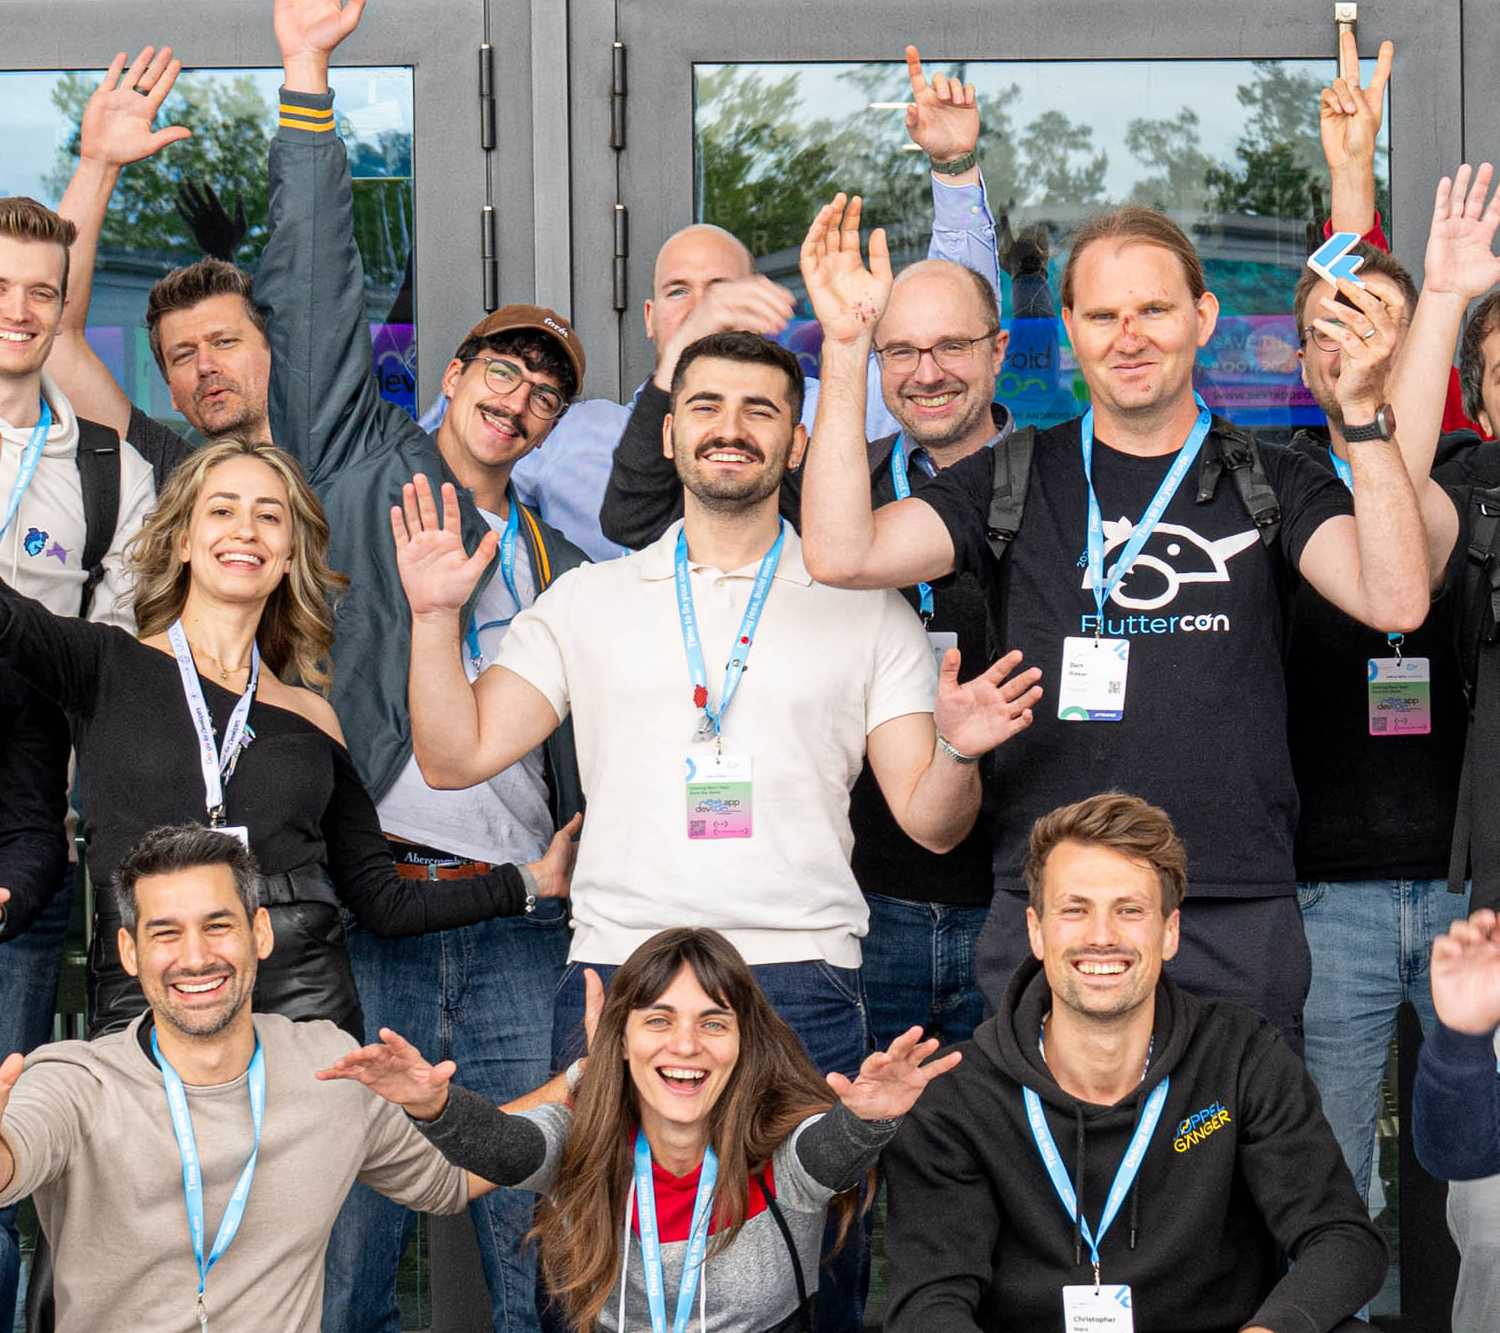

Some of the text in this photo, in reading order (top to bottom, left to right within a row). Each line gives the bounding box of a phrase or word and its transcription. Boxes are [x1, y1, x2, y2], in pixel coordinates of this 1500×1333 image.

[642, 1206, 653, 1231] build
[647, 1260, 660, 1297] Debug
[1073, 1315, 1116, 1324] Christopher
